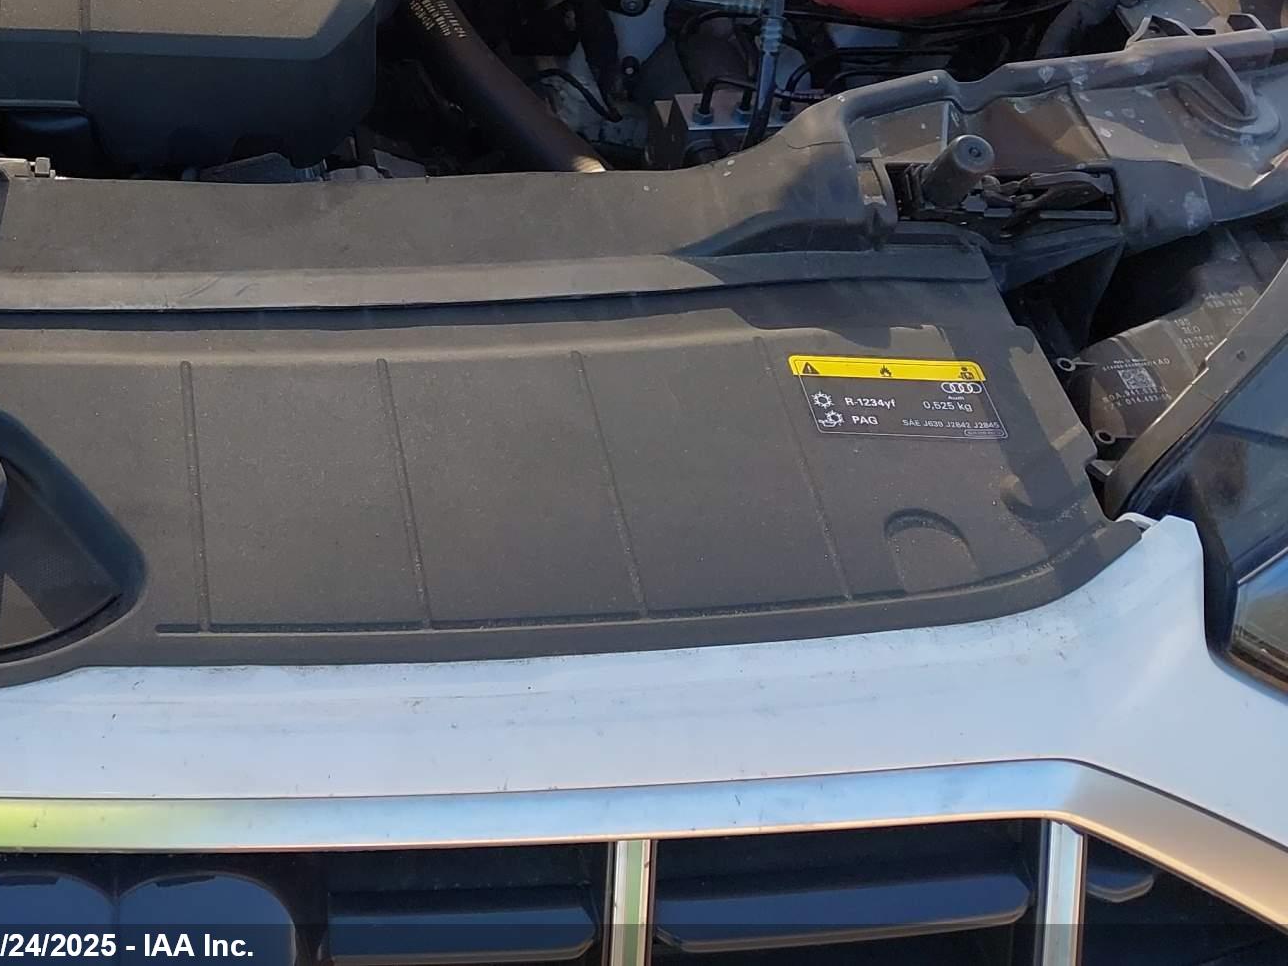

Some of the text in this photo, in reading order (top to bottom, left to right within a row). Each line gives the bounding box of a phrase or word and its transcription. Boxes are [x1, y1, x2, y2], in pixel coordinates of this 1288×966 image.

[844, 397, 896, 409] R-1234yf
[956, 401, 973, 412] kg
[851, 415, 879, 425] PAG
[902, 419, 921, 427] SAE
[946, 421, 972, 429] J2842
[974, 421, 1000, 429] J2845
